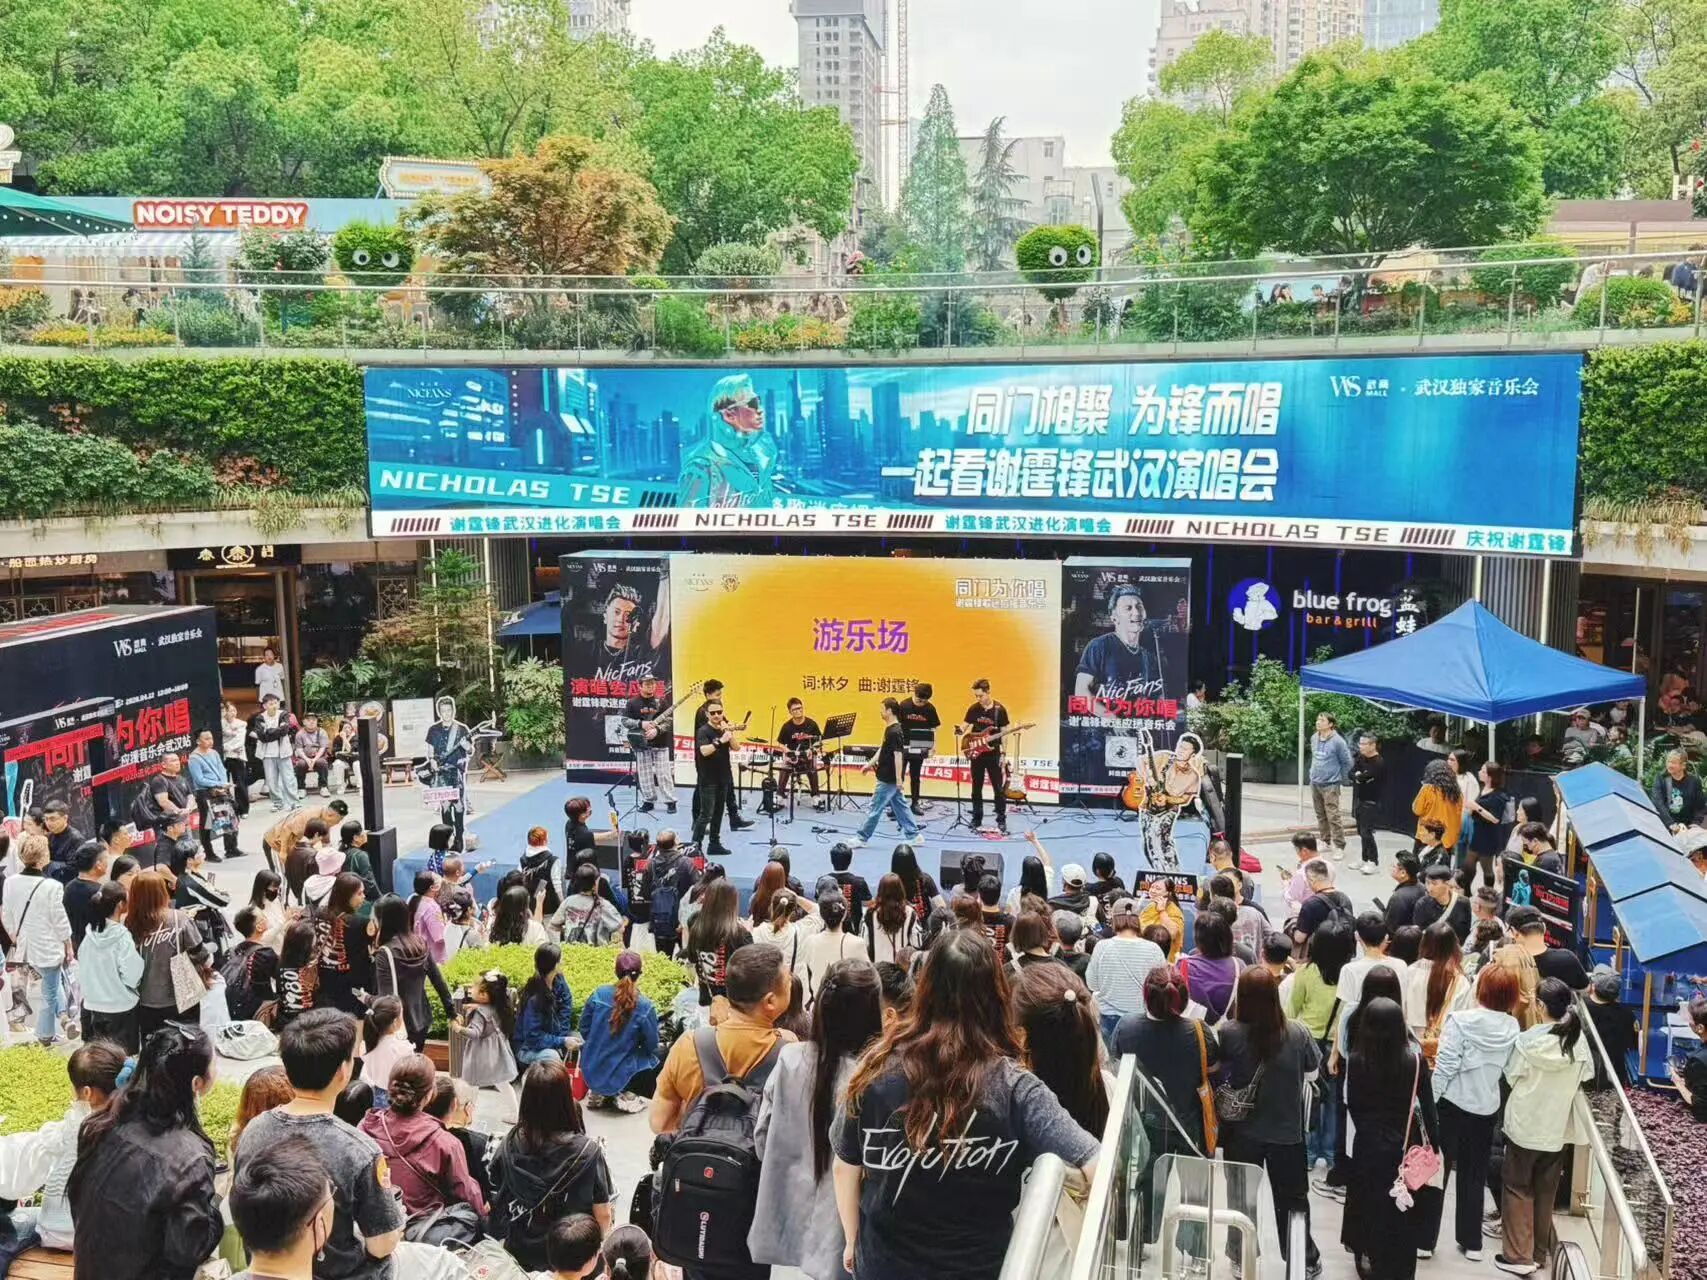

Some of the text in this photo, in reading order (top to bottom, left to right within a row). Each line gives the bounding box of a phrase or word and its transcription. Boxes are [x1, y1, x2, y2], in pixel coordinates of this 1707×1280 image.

[136, 203, 304, 225] NOISY TEDDY
[1414, 377, 1540, 397] 武汉独家音乐会
[966, 382, 1283, 436] 同门相聚 为锋而唱
[881, 447, 1279, 500] 一起看谢霆锋武汉演唱会
[380, 469, 631, 505] NICHOLAS TSE
[450, 514, 622, 531] 谢霆锋武汉进化演唱会
[695, 513, 877, 528] NICHOLAS TSE
[945, 515, 1112, 533] 谢霆锋武汉进化演唱会
[1186, 521, 1390, 543] NICHOLAS TSE
[1466, 530, 1567, 551] 庆祝谢霆锋
[954, 578, 1047, 598] 同门为你唱
[1293, 589, 1392, 618] blue frog
[1306, 613, 1331, 624] bar
[1345, 616, 1377, 629] grill
[812, 617, 910, 654] 游乐场
[594, 660, 652, 681] NicFans
[802, 675, 849, 692] 词:林夕
[1096, 678, 1163, 700] NicFans
[1068, 696, 1178, 719] 同门为你唱
